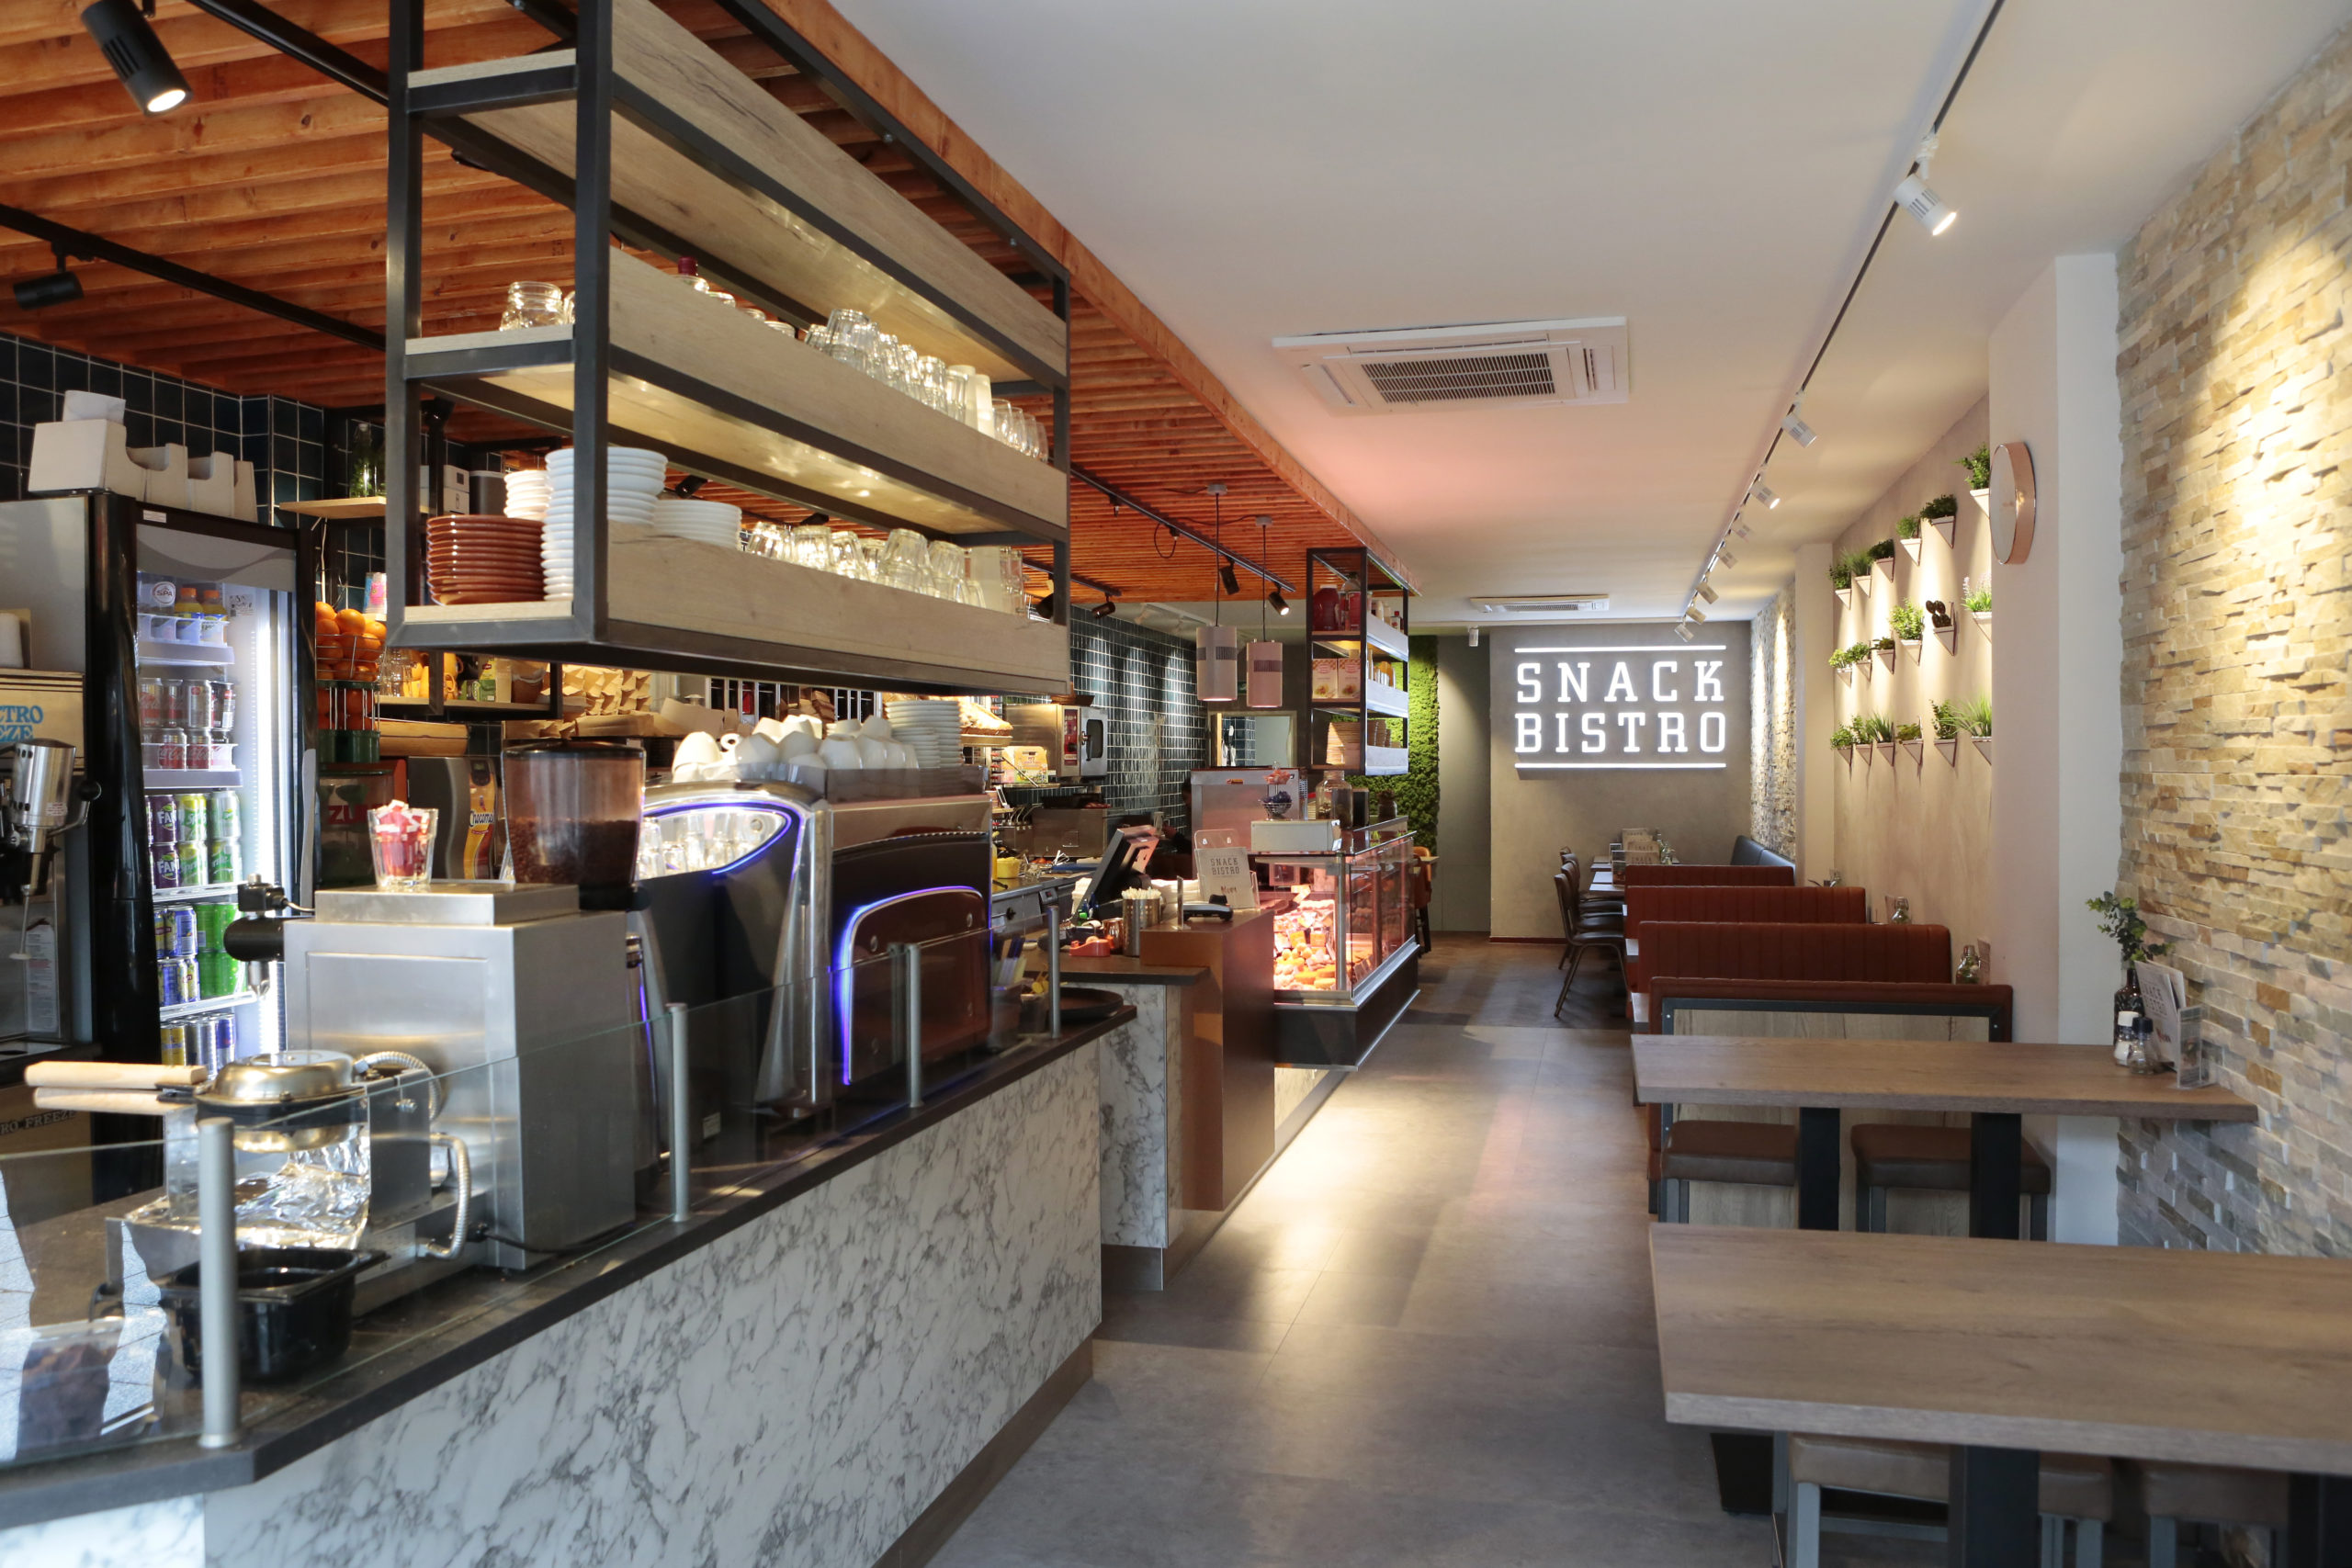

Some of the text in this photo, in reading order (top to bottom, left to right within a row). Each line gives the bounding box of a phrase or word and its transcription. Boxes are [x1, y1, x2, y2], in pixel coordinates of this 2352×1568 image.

[156, 589, 173, 597] SPA
[1517, 660, 1724, 703] SNACK
[1515, 712, 1725, 753] BISTRO
[1211, 857, 1238, 867] SNACK
[1213, 866, 1239, 875] BISTRO
